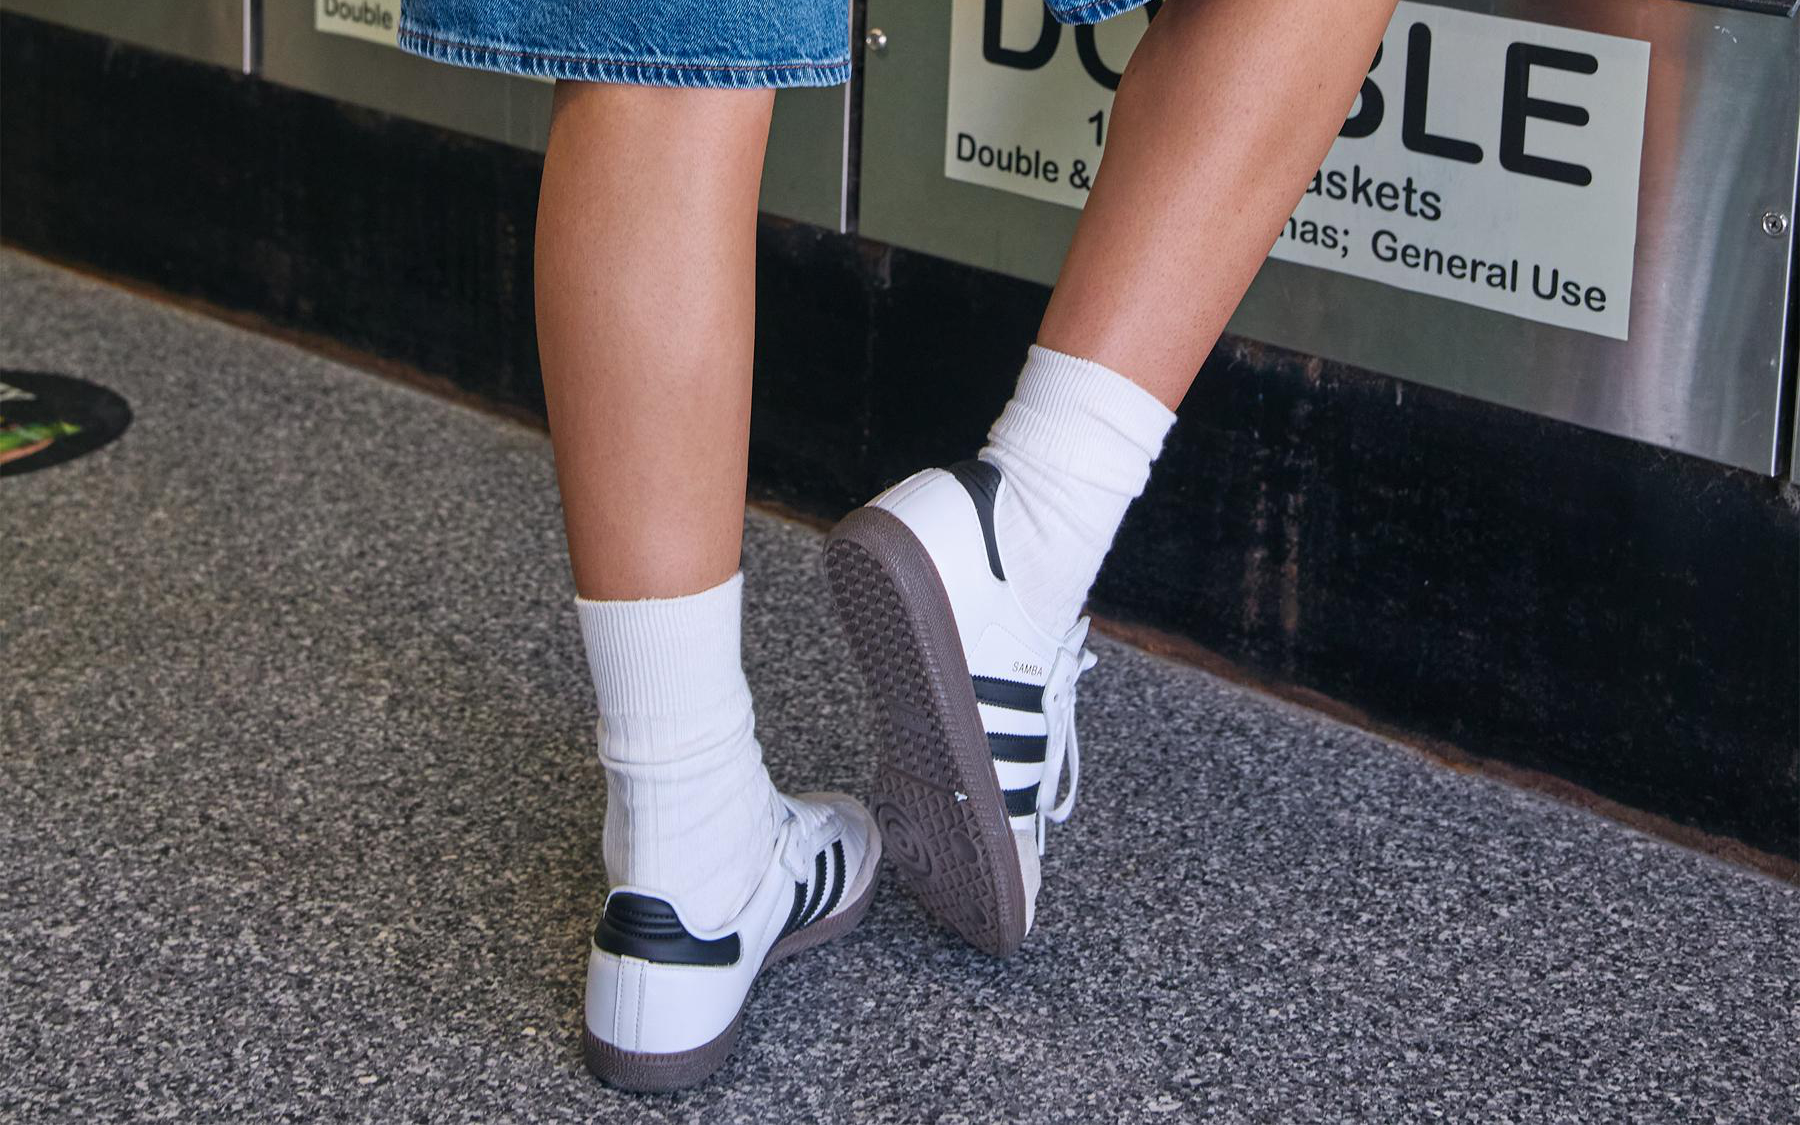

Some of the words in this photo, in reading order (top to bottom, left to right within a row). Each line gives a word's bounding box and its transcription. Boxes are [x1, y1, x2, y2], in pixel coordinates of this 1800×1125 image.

[957, 132, 1059, 183] Double
[1069, 159, 1091, 191] &
[1372, 229, 1518, 293] General
[1532, 264, 1608, 313] Use
[1012, 661, 1043, 677] SAMBA
